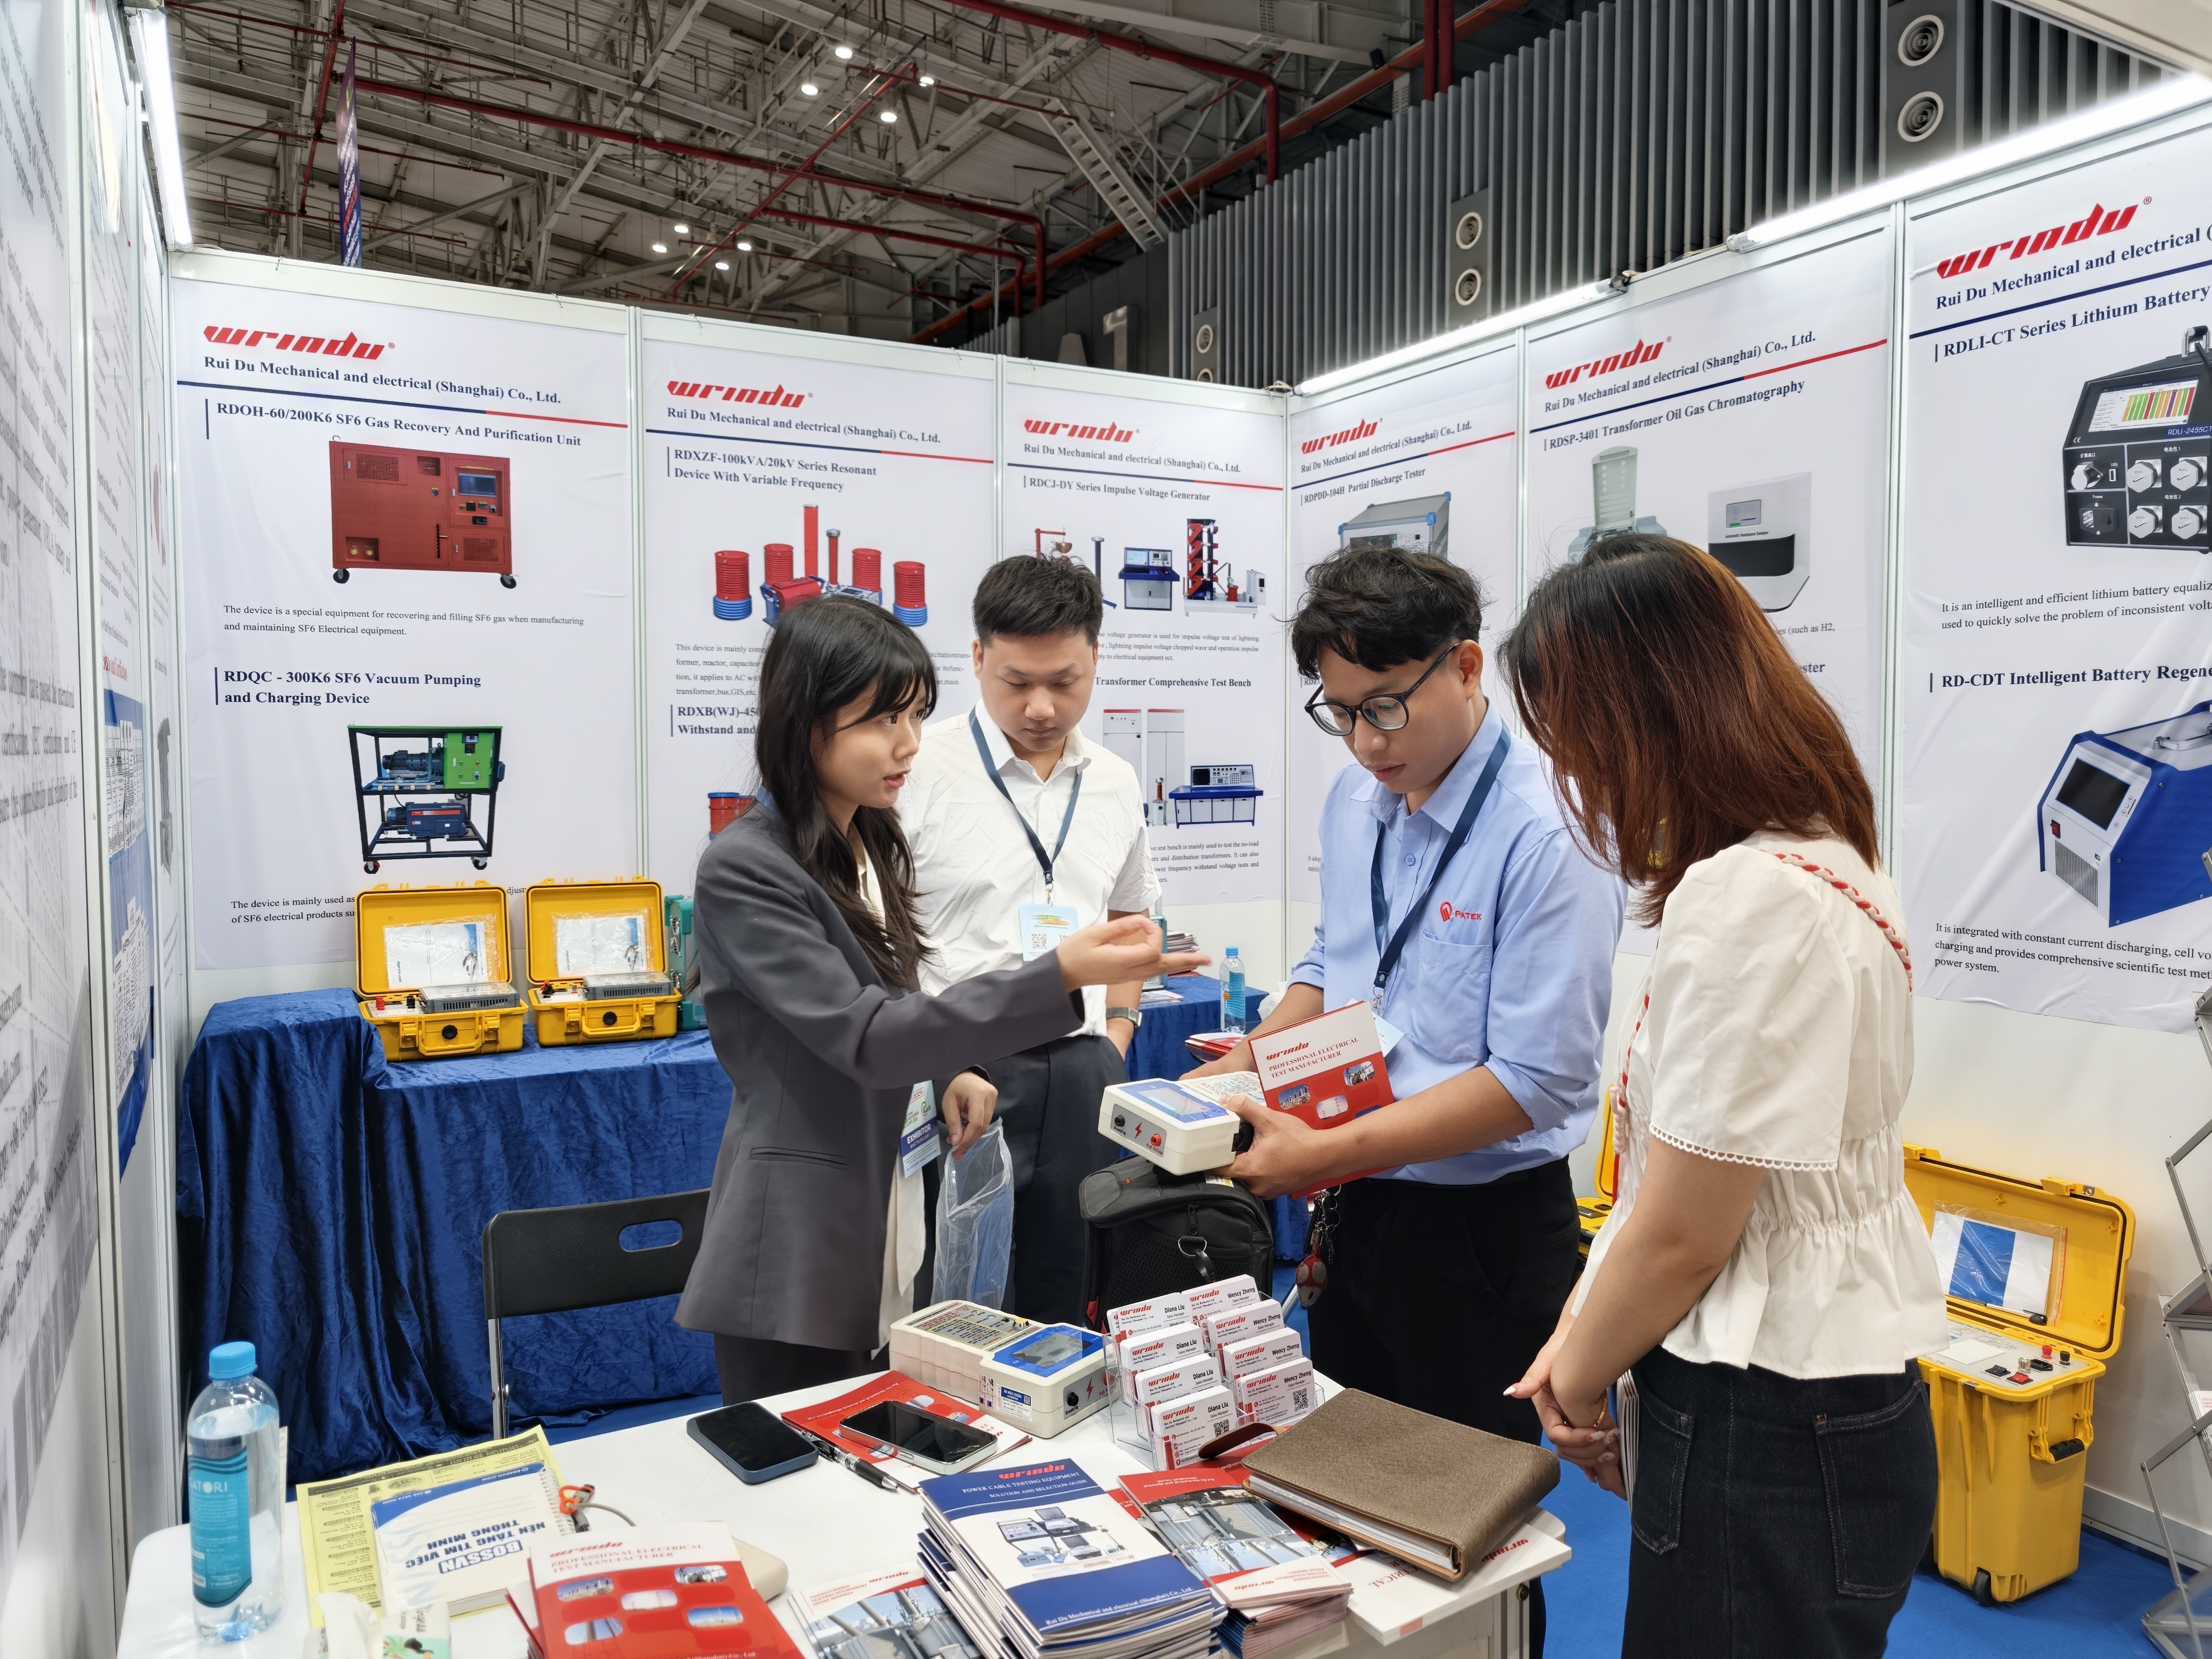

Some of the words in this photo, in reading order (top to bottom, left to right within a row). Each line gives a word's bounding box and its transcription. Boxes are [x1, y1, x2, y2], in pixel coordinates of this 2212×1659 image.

[1936, 291, 1961, 310] Rui
[1966, 288, 1986, 302] Du
[1992, 259, 2080, 295] Mechanical
[2085, 250, 2115, 271] and
[2121, 227, 2201, 261] electrical
[1944, 328, 2015, 358] RDLI-CT
[2020, 320, 2066, 339] Series
[2071, 303, 2138, 328] Lithium
[2143, 286, 2210, 311] Battery
[204, 356, 230, 369] Rui
[234, 359, 255, 372] Du
[260, 362, 339, 380] Mechanical
[343, 373, 368, 383] and
[373, 374, 431, 390] electrical
[436, 381, 504, 400] (Shanghai)
[508, 388, 532, 402] Co.,
[536, 391, 561, 403] Ltd.
[1545, 400, 1560, 413] Rui
[1562, 397, 1575, 408] Du
[1577, 380, 1629, 404] Mechanical
[1632, 375, 1650, 389] and
[1653, 361, 1699, 383] electrical
[1702, 345, 1761, 373] (Shanghai)
[1765, 341, 1788, 354] Co.,
[1791, 331, 1816, 347] Ltd.
[217, 403, 332, 423] RDOH-60/200K6
[336, 414, 361, 426] SF6
[365, 416, 389, 428] Gas
[394, 419, 451, 436] Recovery
[455, 426, 480, 436] And
[484, 428, 552, 443] Purification
[557, 434, 581, 446] Unit
[667, 407, 687, 419] Rui
[690, 409, 706, 420] Du
[710, 412, 770, 427] Mechanical
[773, 419, 792, 429] and
[795, 421, 840, 433] electrical
[844, 426, 896, 440] (Shanghai)
[899, 430, 918, 441] Co.,
[921, 433, 941, 443] Ltd.
[1550, 428, 1598, 449] RDSP-3401
[1602, 415, 1663, 436] Transformer
[1665, 408, 1681, 421] Oil
[1684, 405, 1704, 417] Gas
[1708, 381, 1805, 412] Chromatography
[1024, 443, 1040, 454] Rui
[1042, 445, 1054, 455] Du
[1057, 447, 1105, 460] Mechanical
[1108, 453, 1123, 461] and
[1125, 454, 1162, 465] electrical
[1164, 457, 1206, 470] (Shanghai)
[1208, 462, 1223, 472] Co.,
[1225, 463, 1240, 473] Ltd.
[1301, 463, 1311, 473] Rui
[1313, 462, 1321, 470] Du
[1323, 451, 1357, 467] Mechanical
[1358, 447, 1370, 458] and
[1371, 439, 1400, 455] electrical
[1401, 429, 1439, 448] (Shanghai)
[1440, 427, 1455, 436] Co.,
[1457, 421, 1472, 433] Ltd.
[675, 449, 795, 468] RDXZF-100kVA/20kV
[798, 460, 828, 471] Series
[831, 463, 876, 475] Resonant
[675, 468, 710, 480] Device
[713, 471, 739, 482] With
[743, 473, 787, 486] Variable
[791, 477, 842, 493] Frequency
[1030, 477, 1074, 489] RDCJ-DY
[1076, 482, 1101, 492] Series
[1104, 484, 1136, 496] Impulse
[1138, 487, 1169, 499] Voltage
[1170, 490, 1210, 501] Generator
[1304, 486, 1345, 503] RDPDD-104H
[1348, 480, 1369, 493] Partial
[1371, 474, 1402, 488] Discharge
[1404, 469, 1426, 480] Tester
[1942, 603, 1949, 612] It
[1951, 602, 1959, 611] is
[1975, 598, 2023, 610] intelligent
[2026, 595, 2044, 605] and
[2046, 592, 2089, 603] efficient
[2092, 589, 2129, 599] lithium
[2133, 586, 2170, 596] battery
[224, 622, 240, 630] and
[243, 623, 295, 634] maintaining
[298, 624, 315, 632] SF6
[318, 625, 358, 633] Electrical
[361, 626, 407, 636] equipment.
[1788, 625, 1808, 635] (such
[1821, 623, 1835, 632] H2,
[224, 671, 272, 685] RDQC
[286, 672, 331, 683] 300K6
[335, 672, 361, 684] SF6
[365, 673, 420, 684] Vacuum
[424, 674, 481, 688] Pumping
[1096, 677, 1147, 686] Transformer
[1149, 678, 1209, 688] Comprehensive
[1210, 678, 1226, 686] Test
[1229, 679, 1251, 687] Bench
[1942, 673, 2005, 687] RD-CDT
[2009, 670, 2087, 686] Intelligent
[2092, 669, 2152, 683] Battery
[225, 692, 251, 703] and
[255, 692, 322, 706] Charging
[325, 693, 370, 704] Device
[1455, 910, 1482, 920] PATEK
[1934, 959, 1963, 968] power
[1965, 962, 1999, 973] system.
[1269, 1051, 1318, 1071] PROFESSIONAL
[1318, 1037, 1359, 1056] ELECTRICAL
[1271, 1069, 1287, 1078] TEST
[1289, 1051, 1341, 1073] MANUFACTURER
[907, 1124, 931, 1144] EXHIBITOR
[1284, 1375, 1298, 1383] Wency
[962, 1486, 986, 1495] POWER
[988, 1482, 1011, 1491] CABLE
[1011, 1478, 1041, 1488] TESTING
[1042, 1472, 1080, 1482] EQUIPMENT
[989, 1490, 1020, 1498] SOLUTION
[1036, 1483, 1068, 1493] SELECTION
[1068, 1479, 1088, 1487] GUIDE
[427, 1533, 467, 1550] MINH
[441, 1541, 521, 1573] BOSSVN
